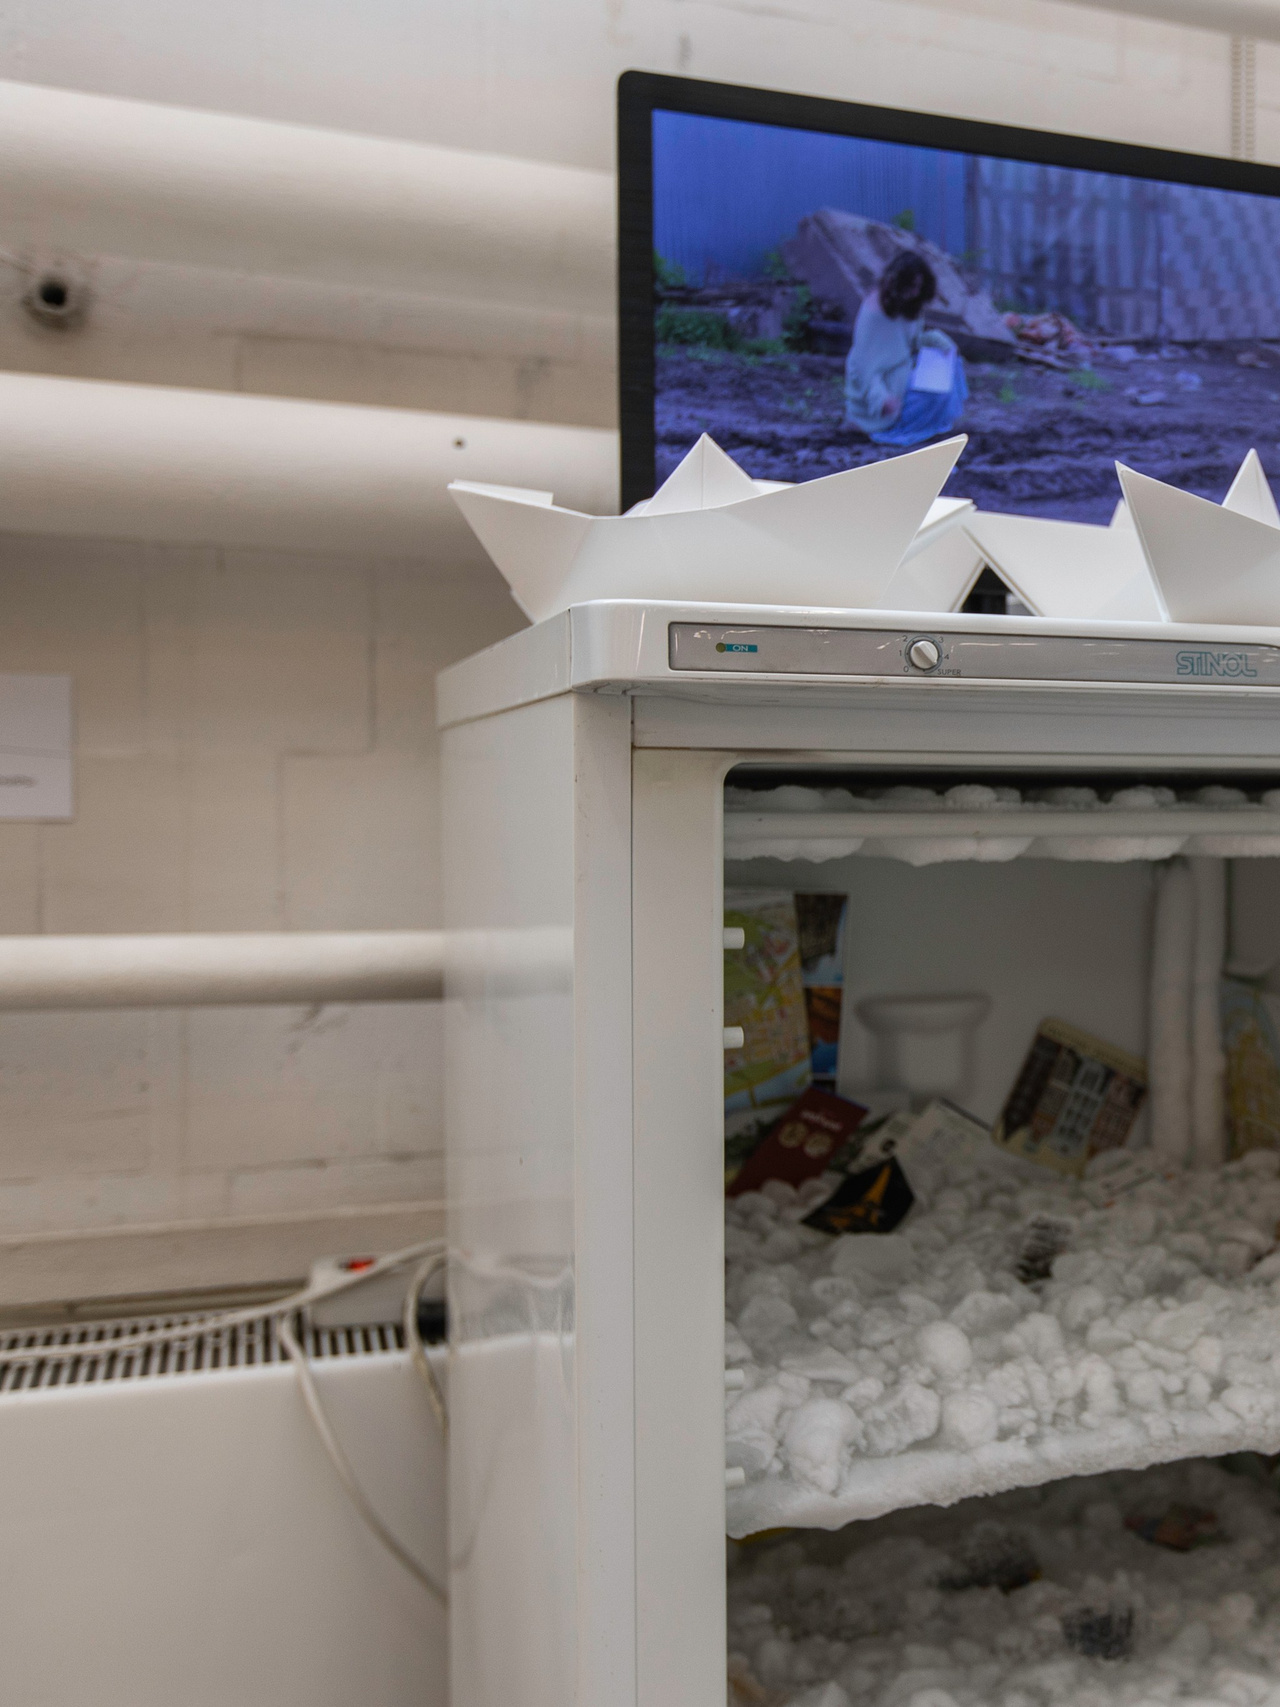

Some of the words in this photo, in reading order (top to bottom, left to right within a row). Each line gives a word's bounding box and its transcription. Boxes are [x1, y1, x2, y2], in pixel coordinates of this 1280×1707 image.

[732, 644, 749, 652] ON
[1176, 651, 1257, 678] STINOL
[937, 668, 962, 676] SUPER
